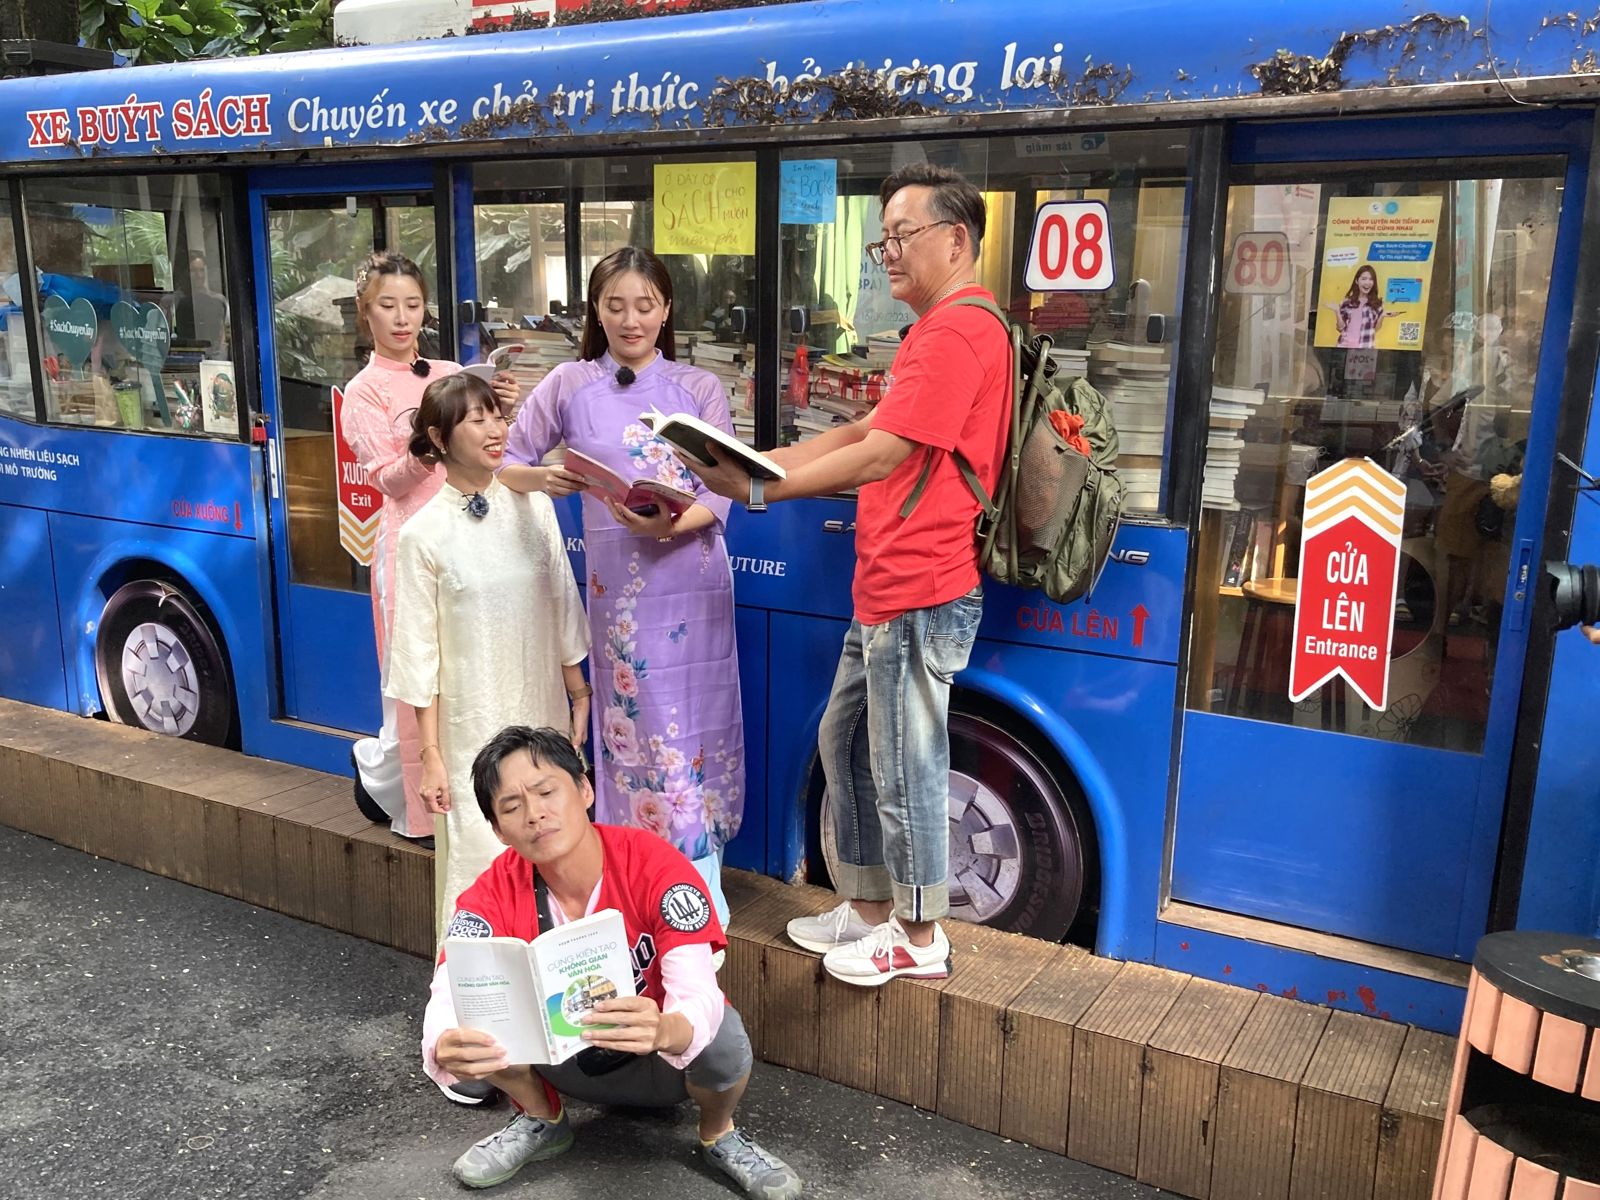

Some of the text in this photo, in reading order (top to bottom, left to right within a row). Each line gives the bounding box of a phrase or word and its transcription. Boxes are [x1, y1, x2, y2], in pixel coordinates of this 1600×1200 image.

[27, 87, 271, 147] XE BUÝT SÁCH
[288, 88, 406, 138] Chuyến
[418, 98, 457, 126] xe
[552, 79, 594, 118] tri
[611, 71, 699, 115] thức
[661, 188, 720, 231] SÁCH
[1038, 212, 1104, 281] 08
[4, 462, 19, 476] MÔ
[20, 465, 57, 481] TRƯỜNG
[10, 446, 36, 461] NHIÊN
[36, 448, 55, 465] LIỆU
[56, 452, 80, 468] SẠCH
[351, 492, 372, 507] Exit
[1326, 540, 1369, 586] CỬA
[1016, 599, 1119, 640] CỬA LÊN
[1321, 591, 1365, 633] LÊN
[1304, 635, 1379, 661] Entrance
[559, 952, 608, 974] KHÔNG GIAN
